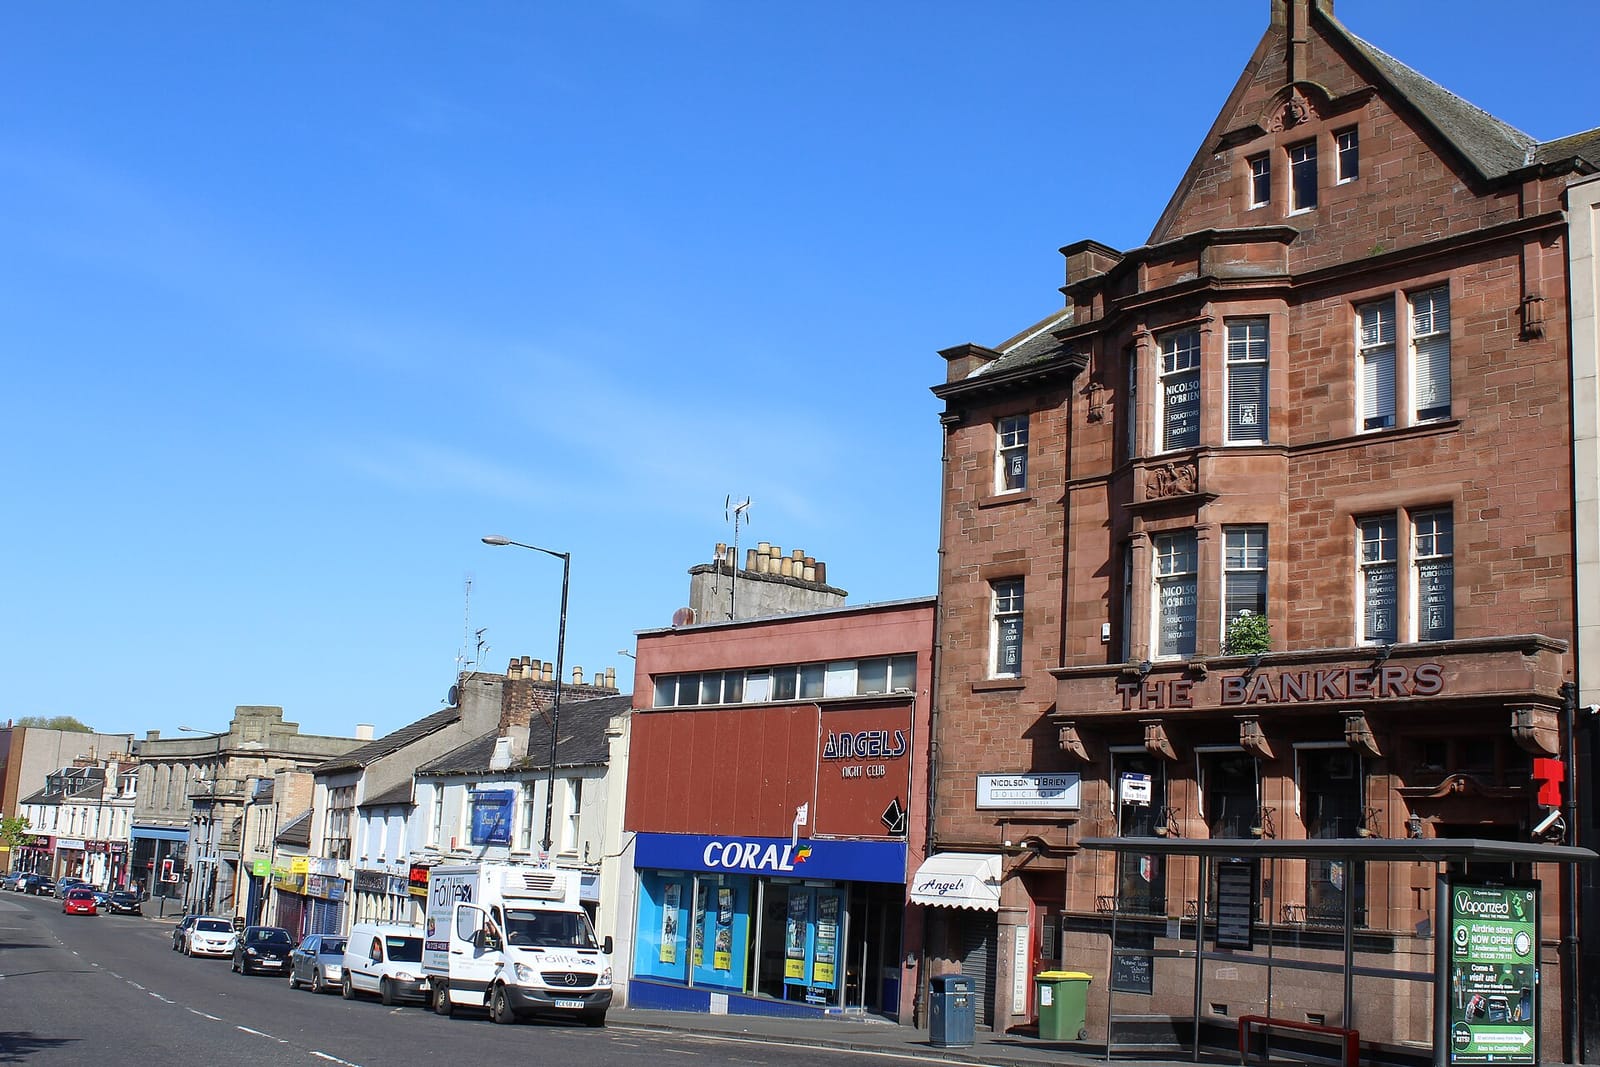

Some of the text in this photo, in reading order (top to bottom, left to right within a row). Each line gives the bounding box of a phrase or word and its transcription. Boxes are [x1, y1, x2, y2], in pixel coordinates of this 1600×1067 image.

[1170, 390, 1199, 404] O'BRIEN
[1172, 425, 1197, 435] NOTARIES
[1427, 584, 1446, 592] SALES
[1115, 662, 1445, 711] THE BANKERS
[823, 730, 906, 758] ANGELS
[842, 765, 886, 777] NIGHT CLUB
[1034, 777, 1066, 786] O'BRIEN
[703, 841, 794, 871] CORAL
[1496, 926, 1513, 934] store
[1472, 935, 1513, 945] NOW OPEN!
[1471, 964, 1489, 972] Come
[1470, 974, 1484, 982] visit
